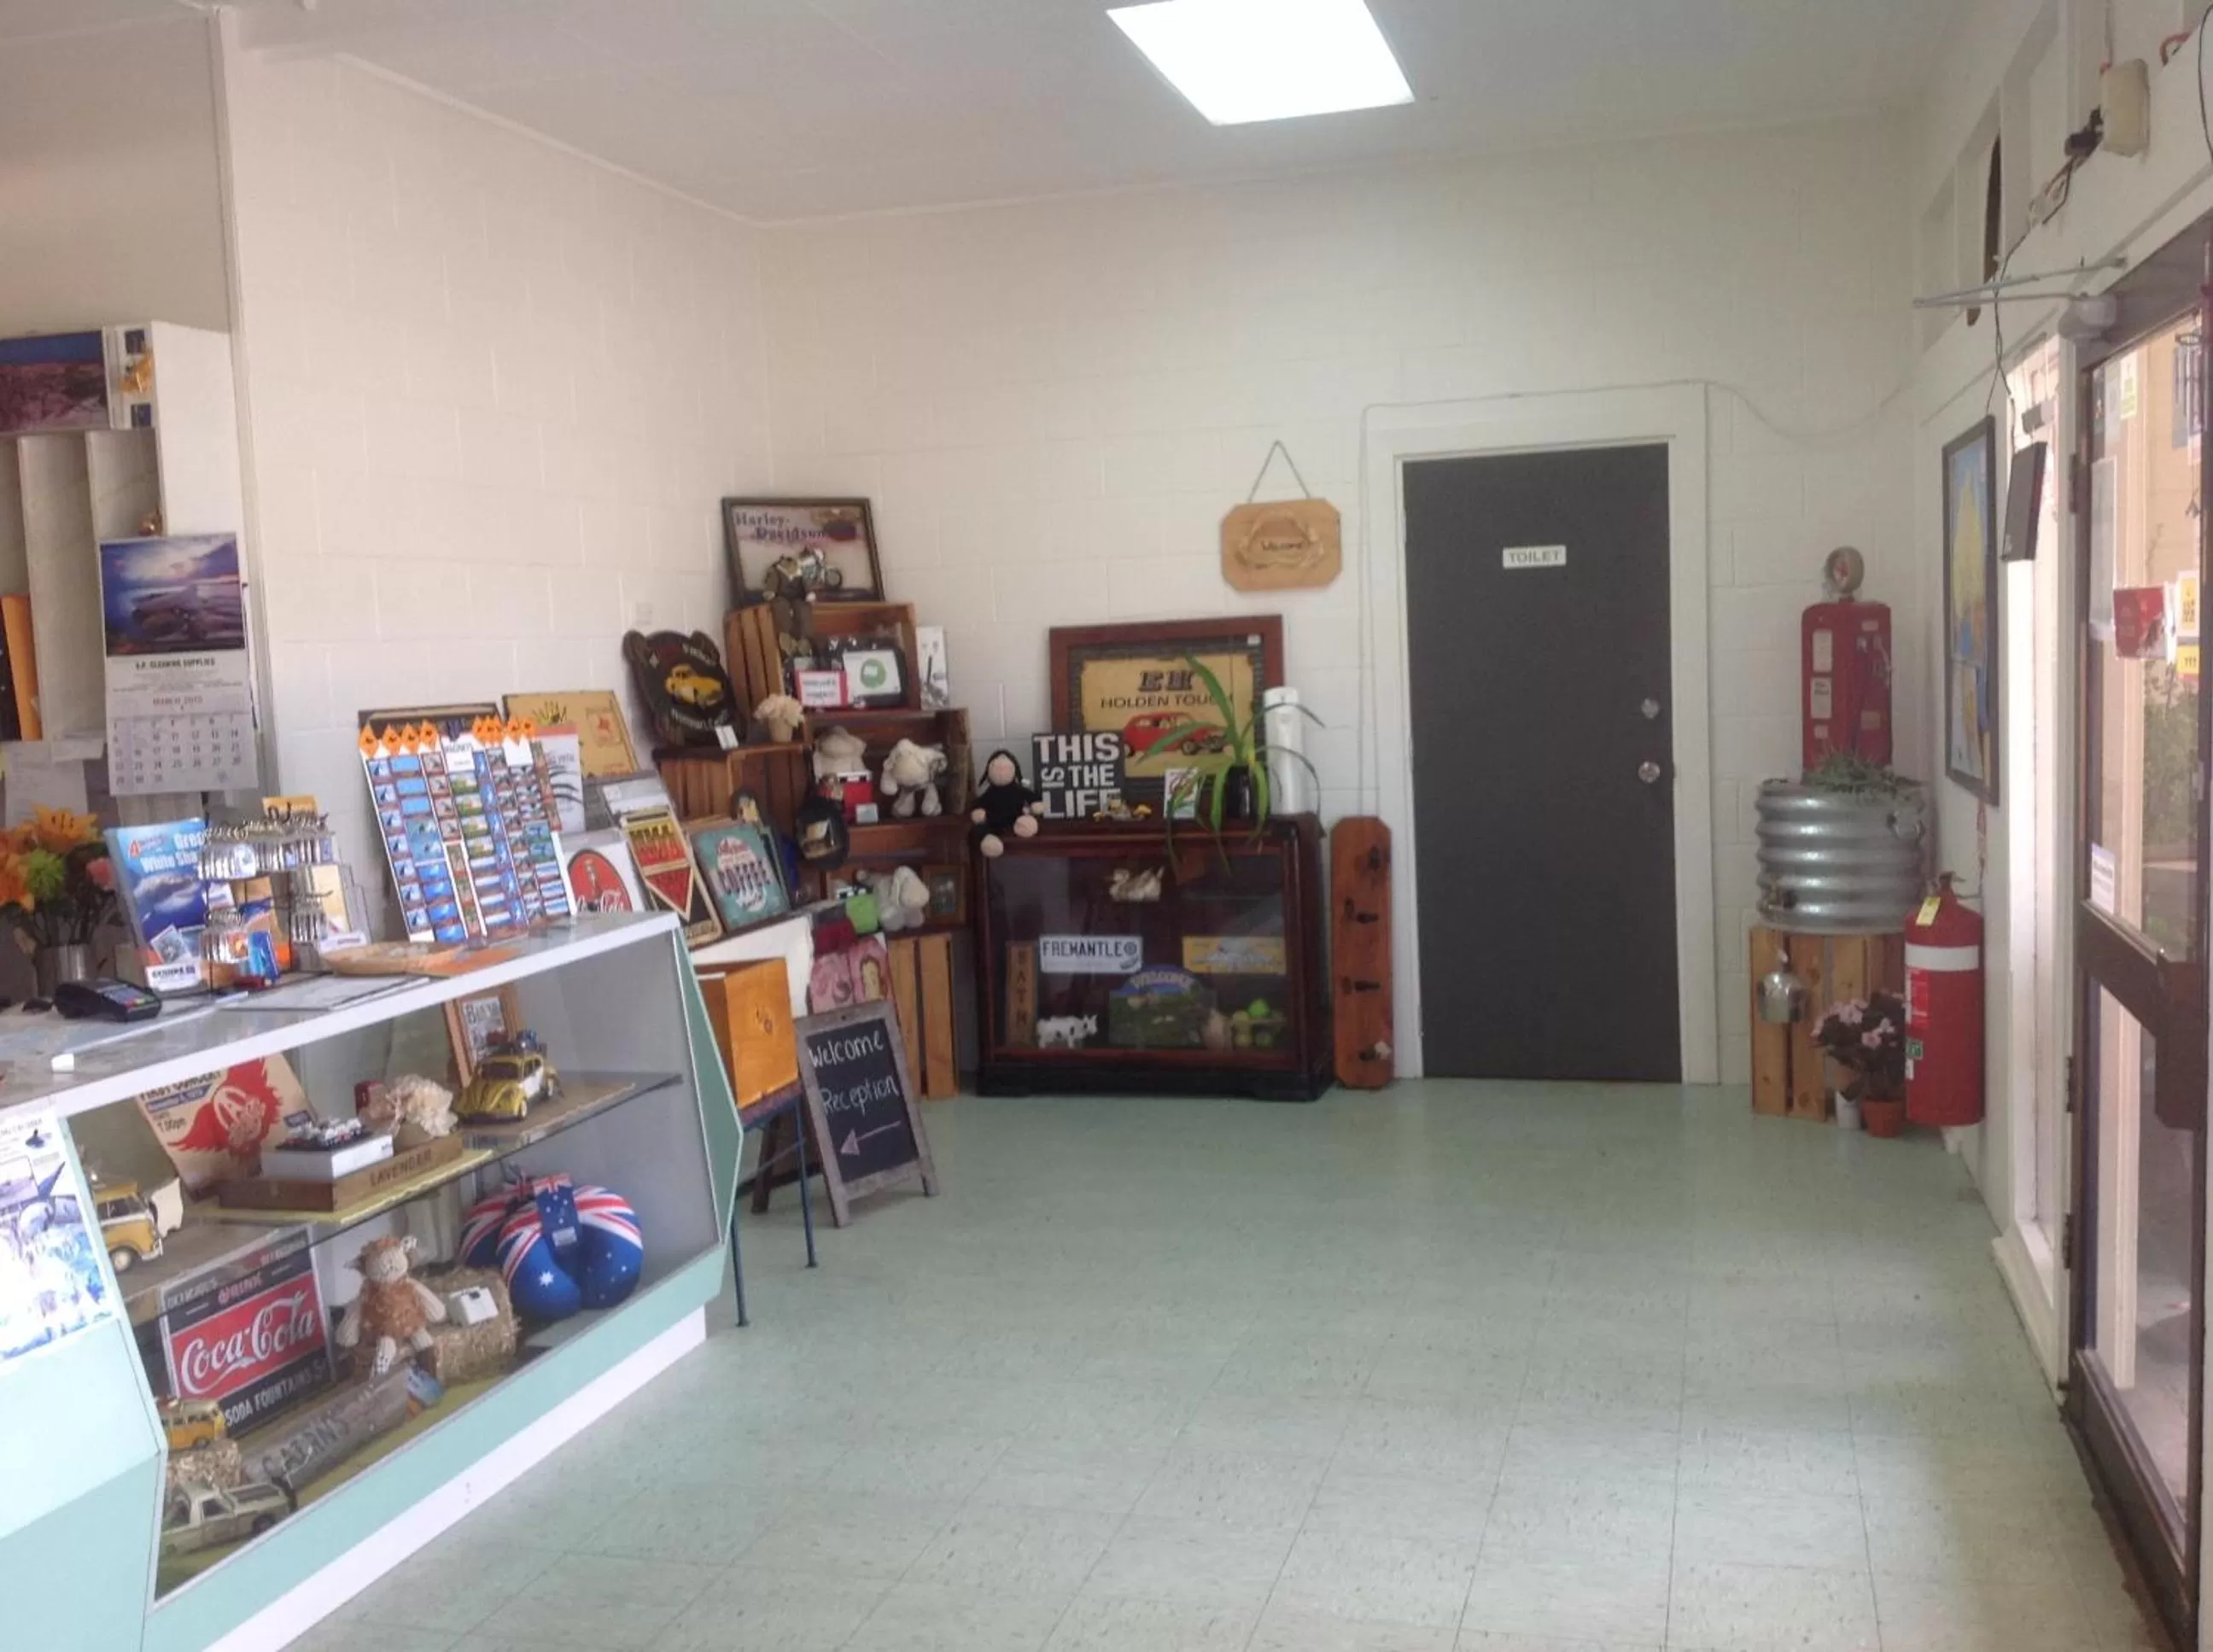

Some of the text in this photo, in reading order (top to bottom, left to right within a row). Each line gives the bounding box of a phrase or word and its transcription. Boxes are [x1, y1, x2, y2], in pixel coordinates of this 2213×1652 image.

[1509, 549, 1560, 564] TOILET
[1101, 695, 1170, 710] HOLDEN
[1032, 732, 1121, 763] THIS
[1041, 764, 1115, 789] IS THE
[1042, 787, 1122, 820] LIFE
[1042, 939, 1124, 958] FREMANTLE
[809, 1030, 885, 1068] Welcome
[820, 1074, 901, 1117] Reception
[181, 1289, 317, 1395] Coca-Cola
[225, 1403, 254, 1428] SODA
